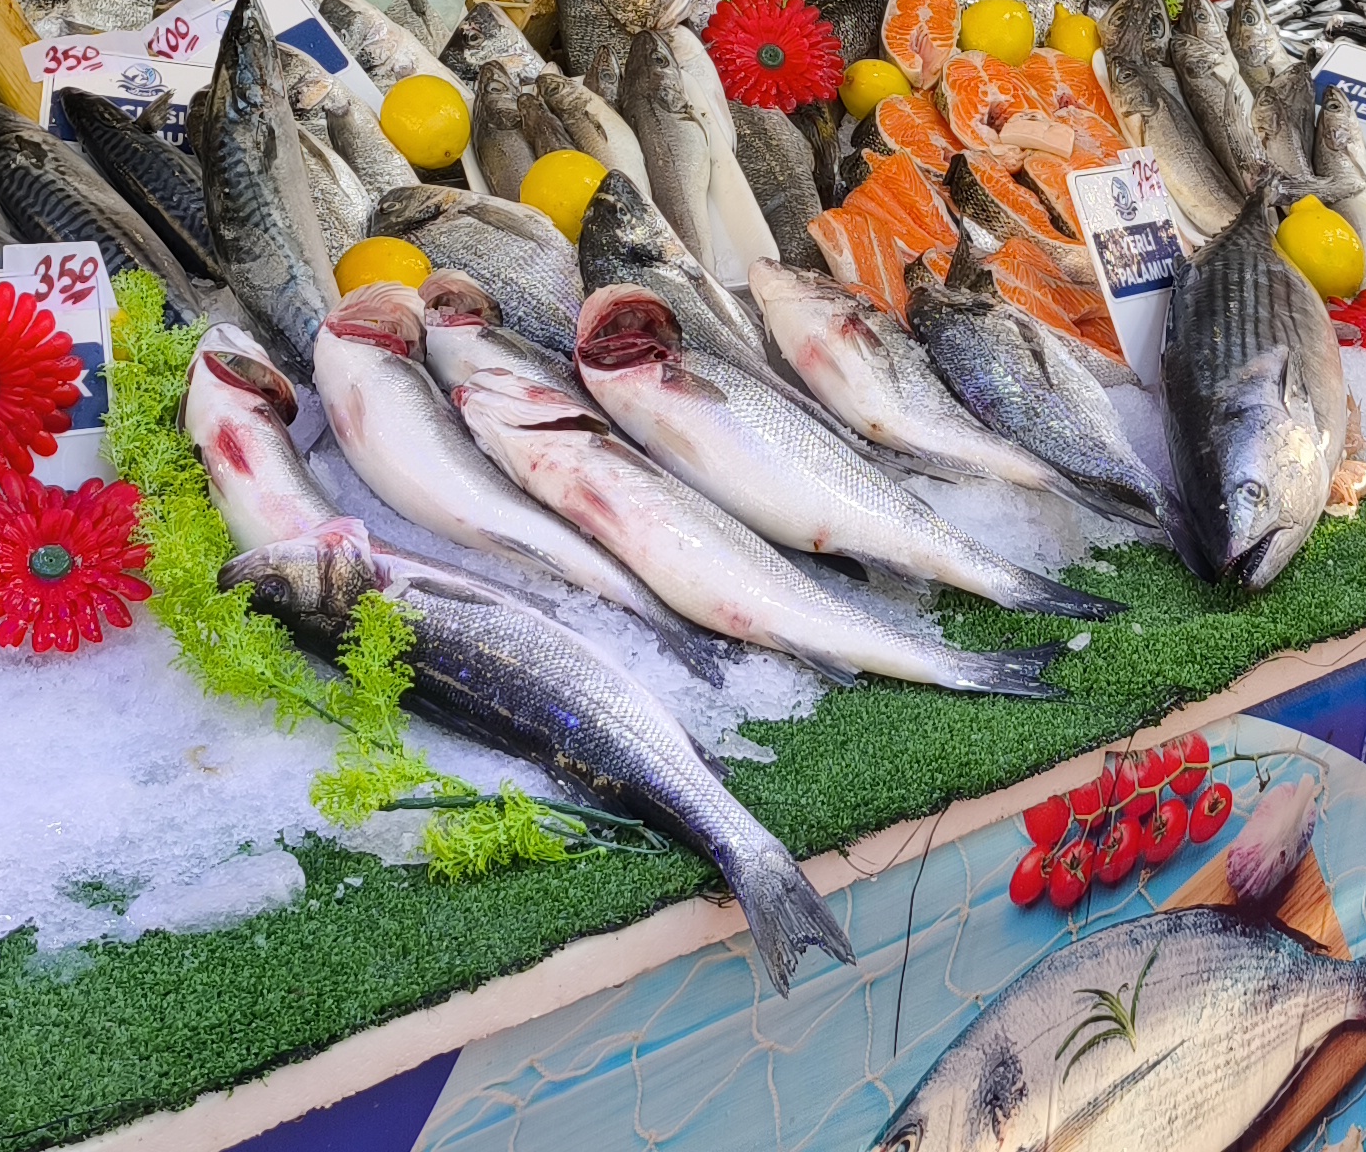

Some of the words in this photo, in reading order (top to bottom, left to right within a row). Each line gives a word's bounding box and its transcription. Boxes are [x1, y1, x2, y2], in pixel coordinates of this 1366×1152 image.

[43, 46, 100, 74] 350
[35, 254, 99, 303] 350
[1118, 257, 1175, 287] PALAMUT
